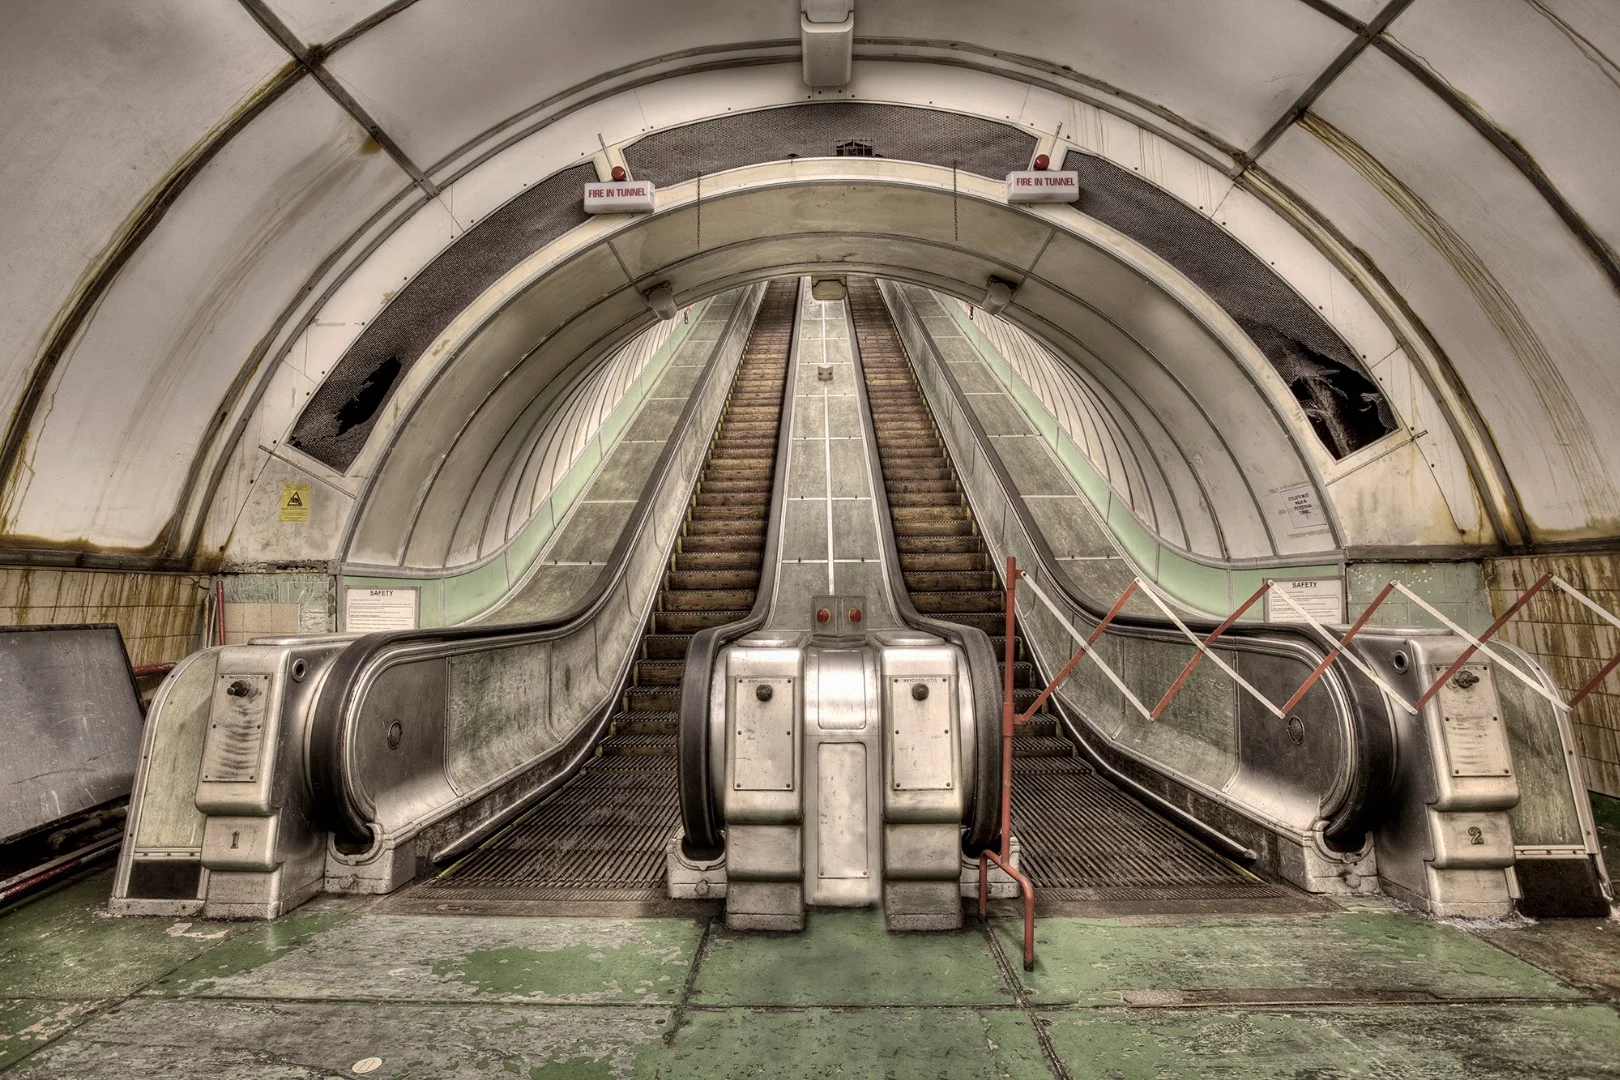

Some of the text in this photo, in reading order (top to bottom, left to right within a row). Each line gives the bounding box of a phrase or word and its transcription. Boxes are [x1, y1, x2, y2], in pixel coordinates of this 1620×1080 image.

[1016, 177, 1075, 186] FIRE IN TUNNEL
[588, 187, 646, 198] FIRE IN TUNNEL
[230, 831, 240, 849] 1
[1467, 826, 1485, 846] 2
